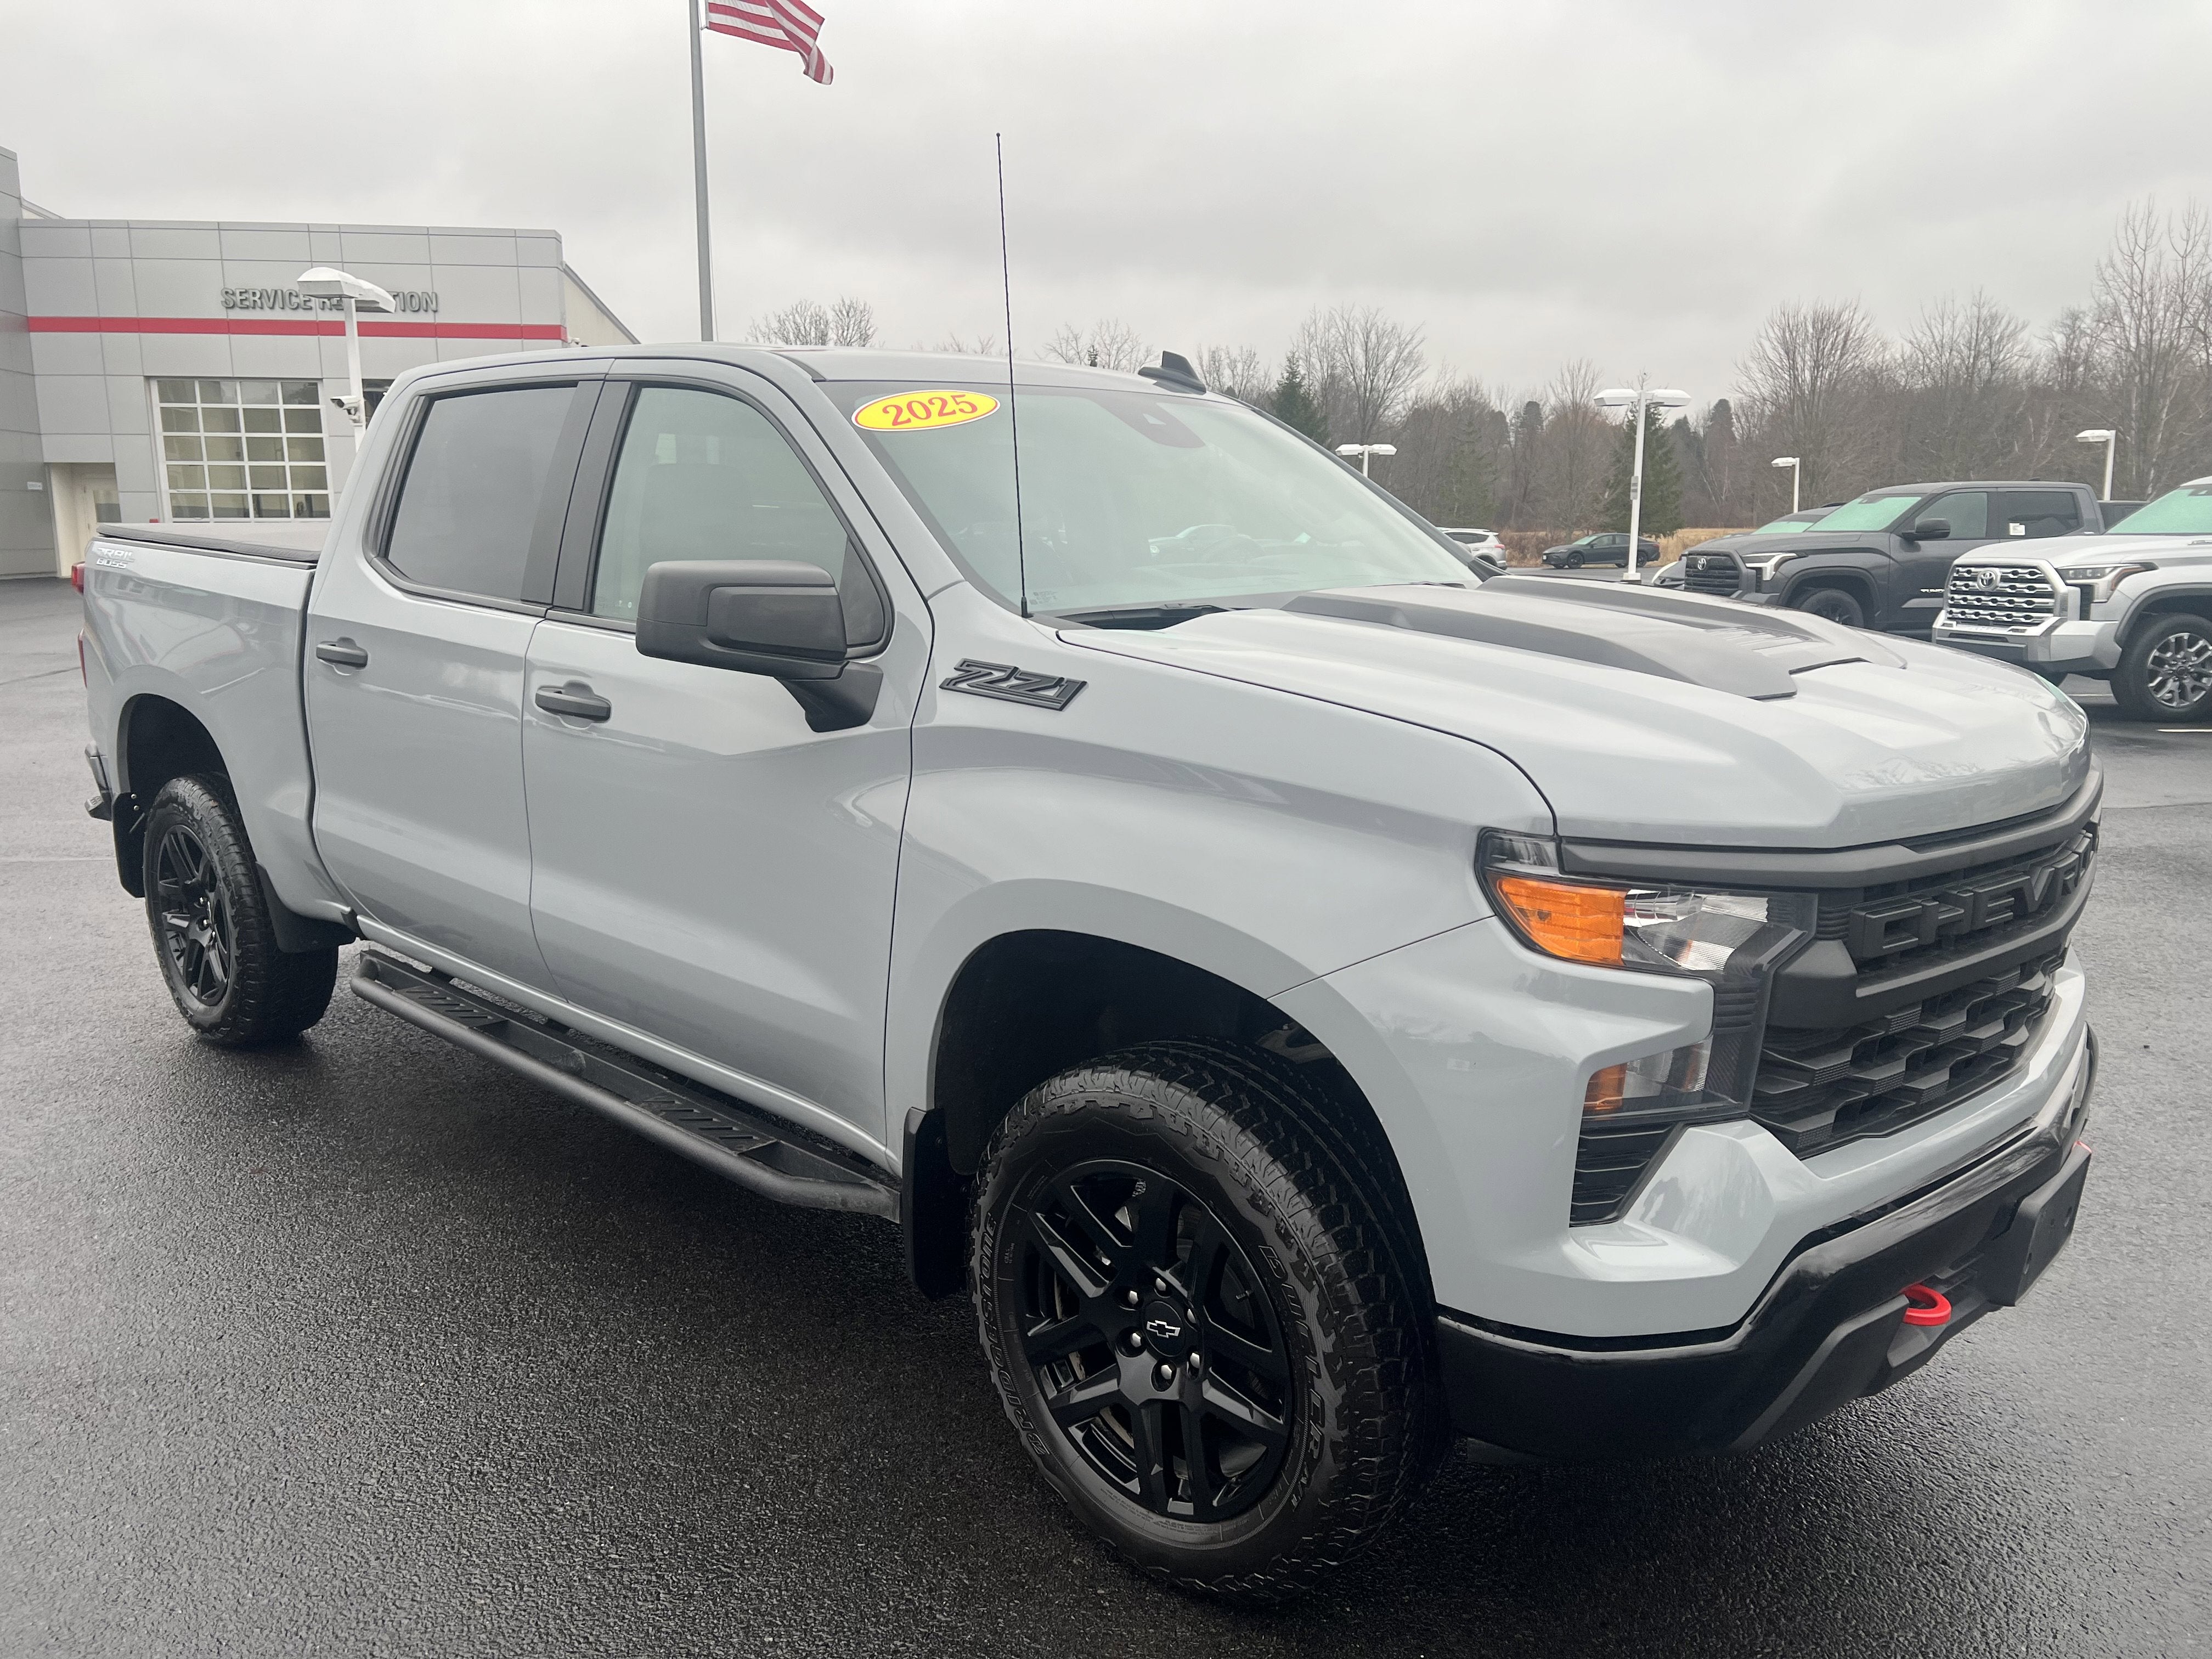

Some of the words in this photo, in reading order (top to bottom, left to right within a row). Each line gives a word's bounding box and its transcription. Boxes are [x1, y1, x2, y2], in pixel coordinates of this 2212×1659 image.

[221, 288, 312, 311] SERVICE
[882, 394, 978, 426] 2025
[96, 557, 127, 569] BOSS
[939, 658, 1088, 712] Z71
[980, 1211, 1050, 1456] BRIDGESTONE
